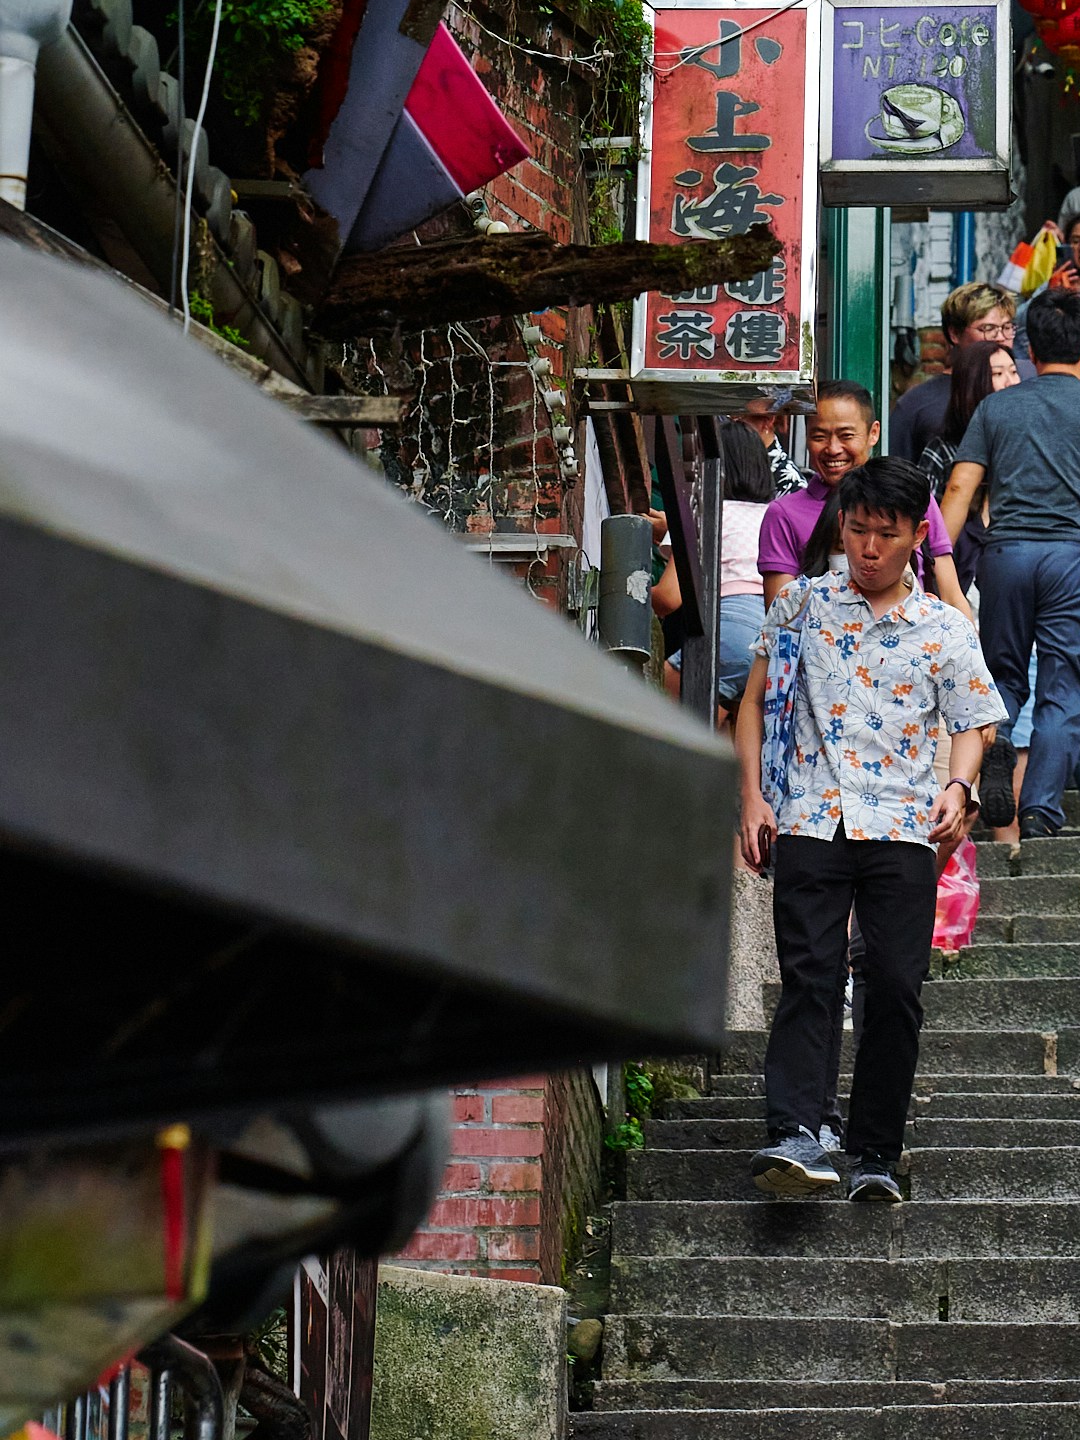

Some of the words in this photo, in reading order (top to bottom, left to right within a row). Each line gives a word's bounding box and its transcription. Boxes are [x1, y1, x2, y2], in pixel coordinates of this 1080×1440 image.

[672, 19, 785, 239] 小上海
[659, 259, 784, 302] 啡
[656, 310, 784, 359] 茶樓
